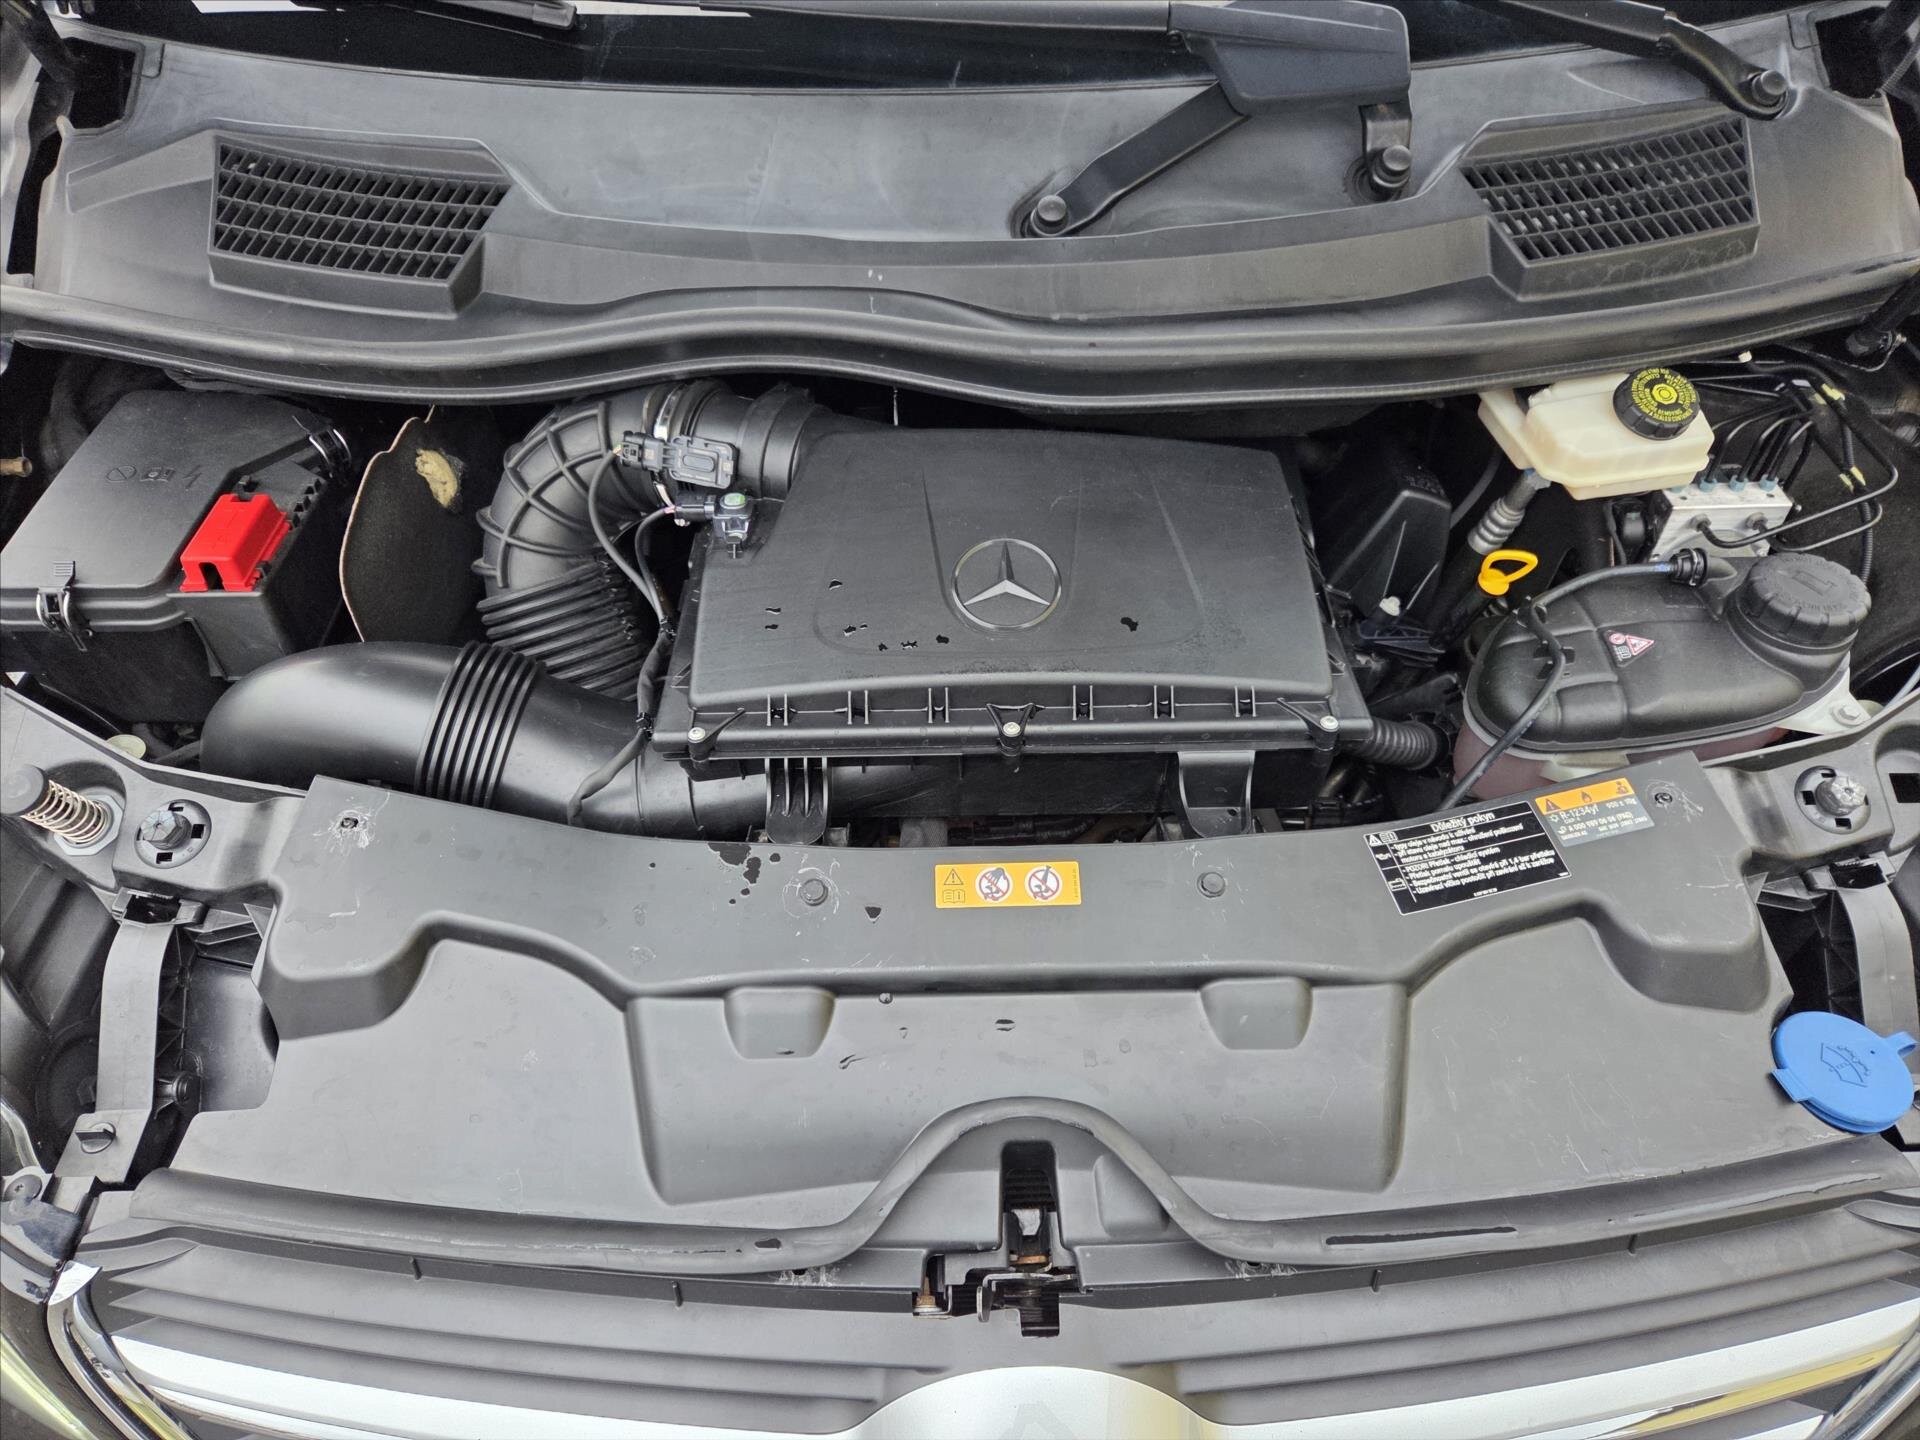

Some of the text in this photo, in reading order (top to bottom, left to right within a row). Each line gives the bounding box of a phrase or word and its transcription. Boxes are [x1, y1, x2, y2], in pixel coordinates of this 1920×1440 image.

[1559, 804, 1600, 820] R-1234yf
[1431, 812, 1496, 832] Důležitý pokyn
[1407, 840, 1423, 848] oleje
